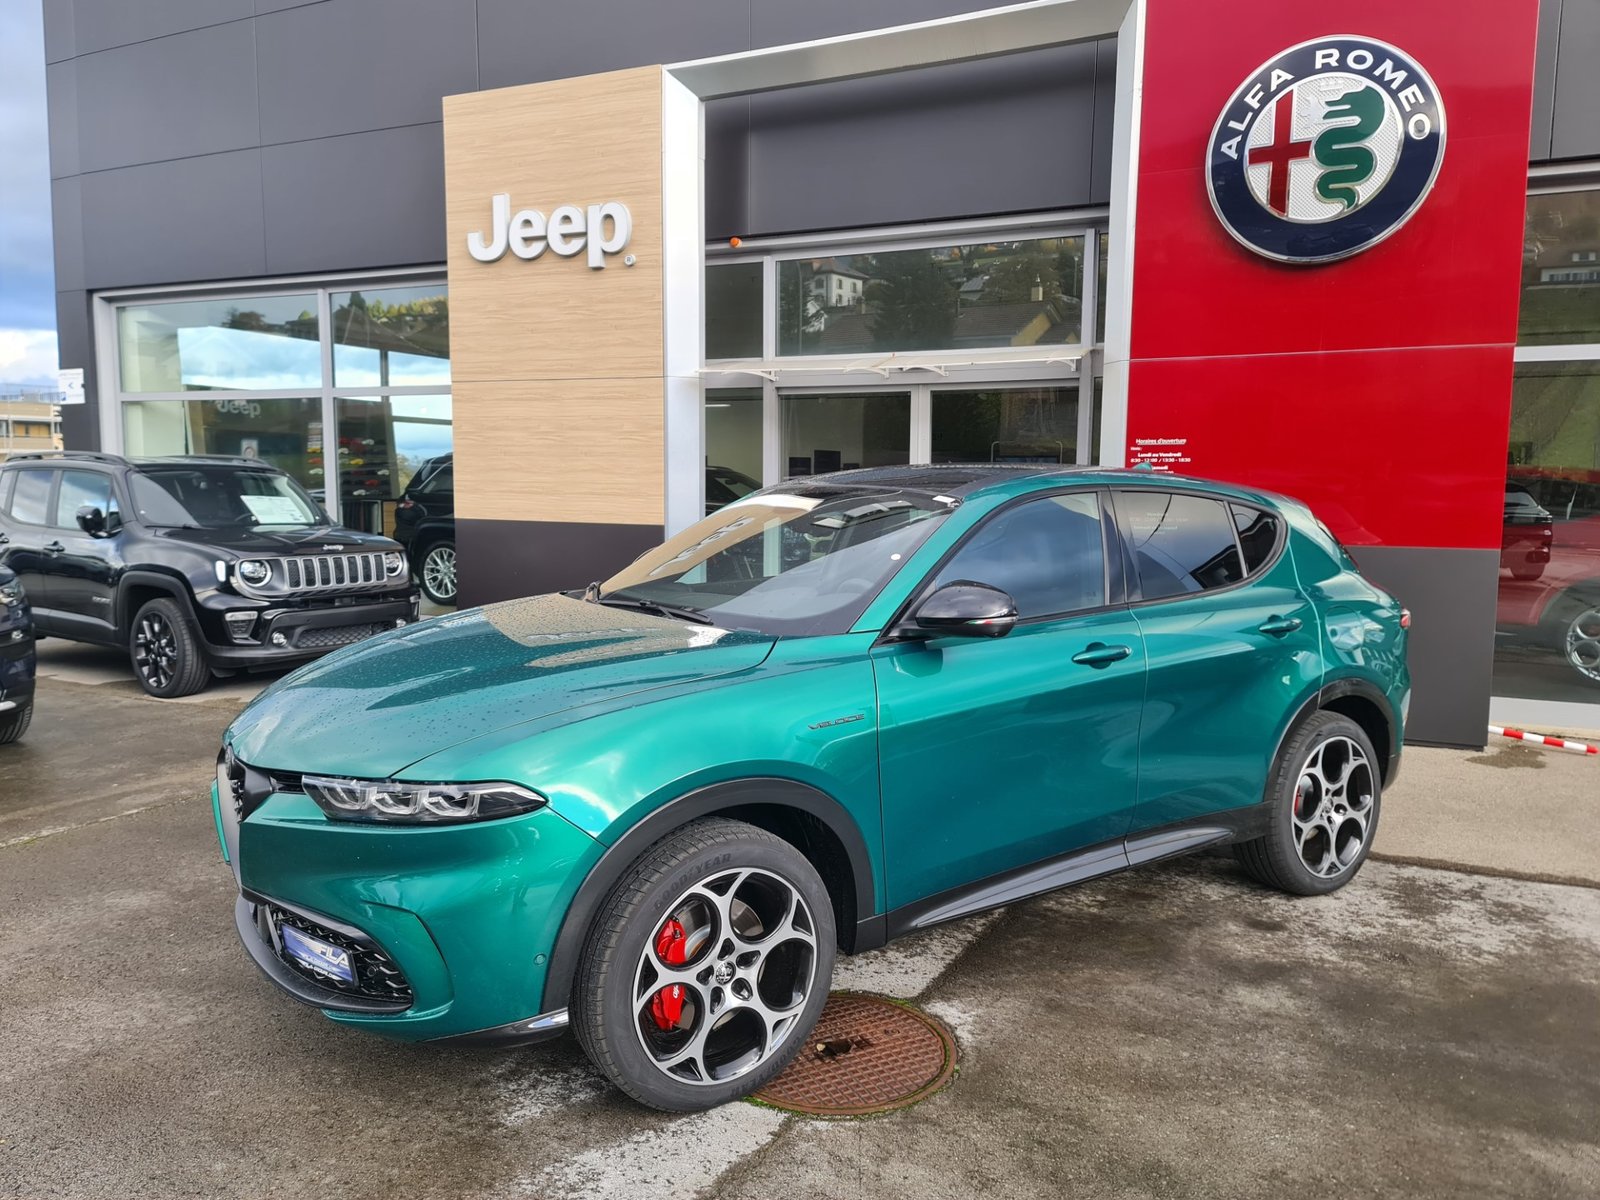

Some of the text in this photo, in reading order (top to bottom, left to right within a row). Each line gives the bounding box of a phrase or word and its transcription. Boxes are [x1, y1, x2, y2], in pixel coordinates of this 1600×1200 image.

[1220, 48, 1431, 160] ALFA ROMEO
[467, 192, 633, 270] Jeep
[808, 714, 865, 730] VELOCE
